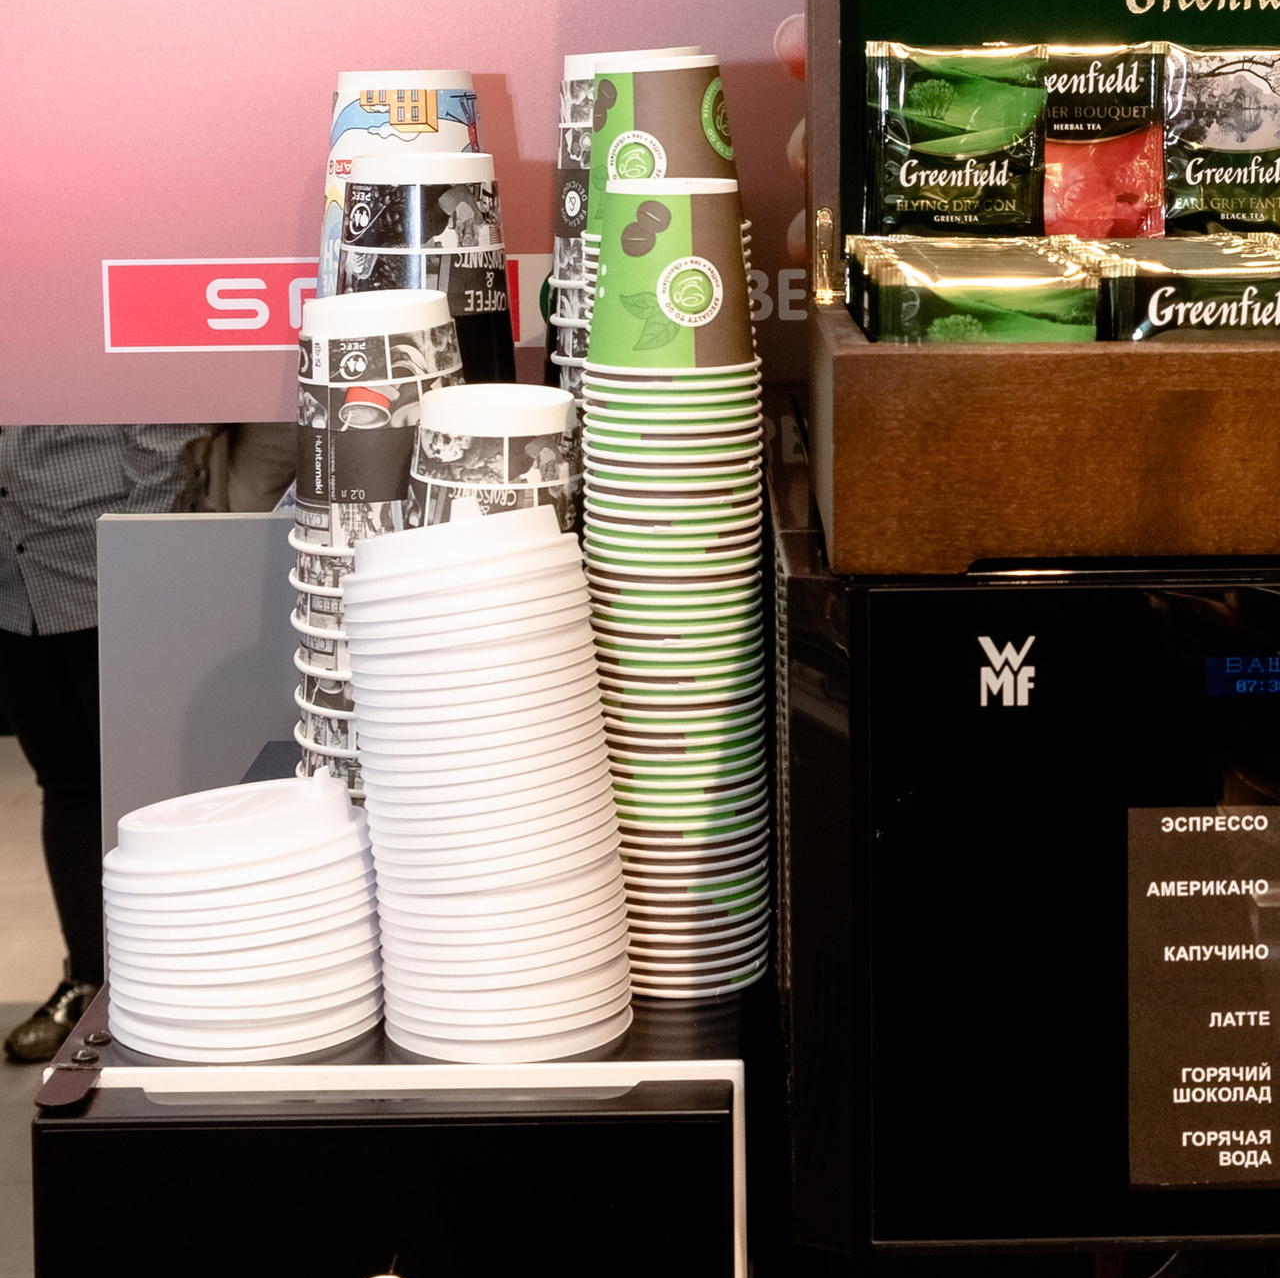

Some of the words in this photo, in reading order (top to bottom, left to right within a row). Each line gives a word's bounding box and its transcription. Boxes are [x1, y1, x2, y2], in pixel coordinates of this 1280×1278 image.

[1047, 61, 1140, 95] eenfield
[1075, 105, 1149, 120] BOUQUET
[900, 159, 1010, 188] Greenfield
[896, 199, 949, 212] FLYING
[953, 199, 1016, 211] DRAGON
[1175, 198, 1207, 209] EARL
[1210, 198, 1248, 209] GREY
[315, 435, 324, 494] Huhtamaki
[1160, 814, 1269, 833] ЭСПРЕССО
[1146, 879, 1269, 898] АМЕРИКАНО
[1163, 944, 1269, 963] КАПУЧИНО
[1209, 1011, 1271, 1028] ЛАТТЕ
[1181, 1062, 1272, 1083] ГОРЯЧИЙ
[1173, 1086, 1272, 1106] ШОКОЛАД
[1181, 1130, 1272, 1148] ГОРЯЧАЯ
[1219, 1150, 1272, 1169] ВОДА
